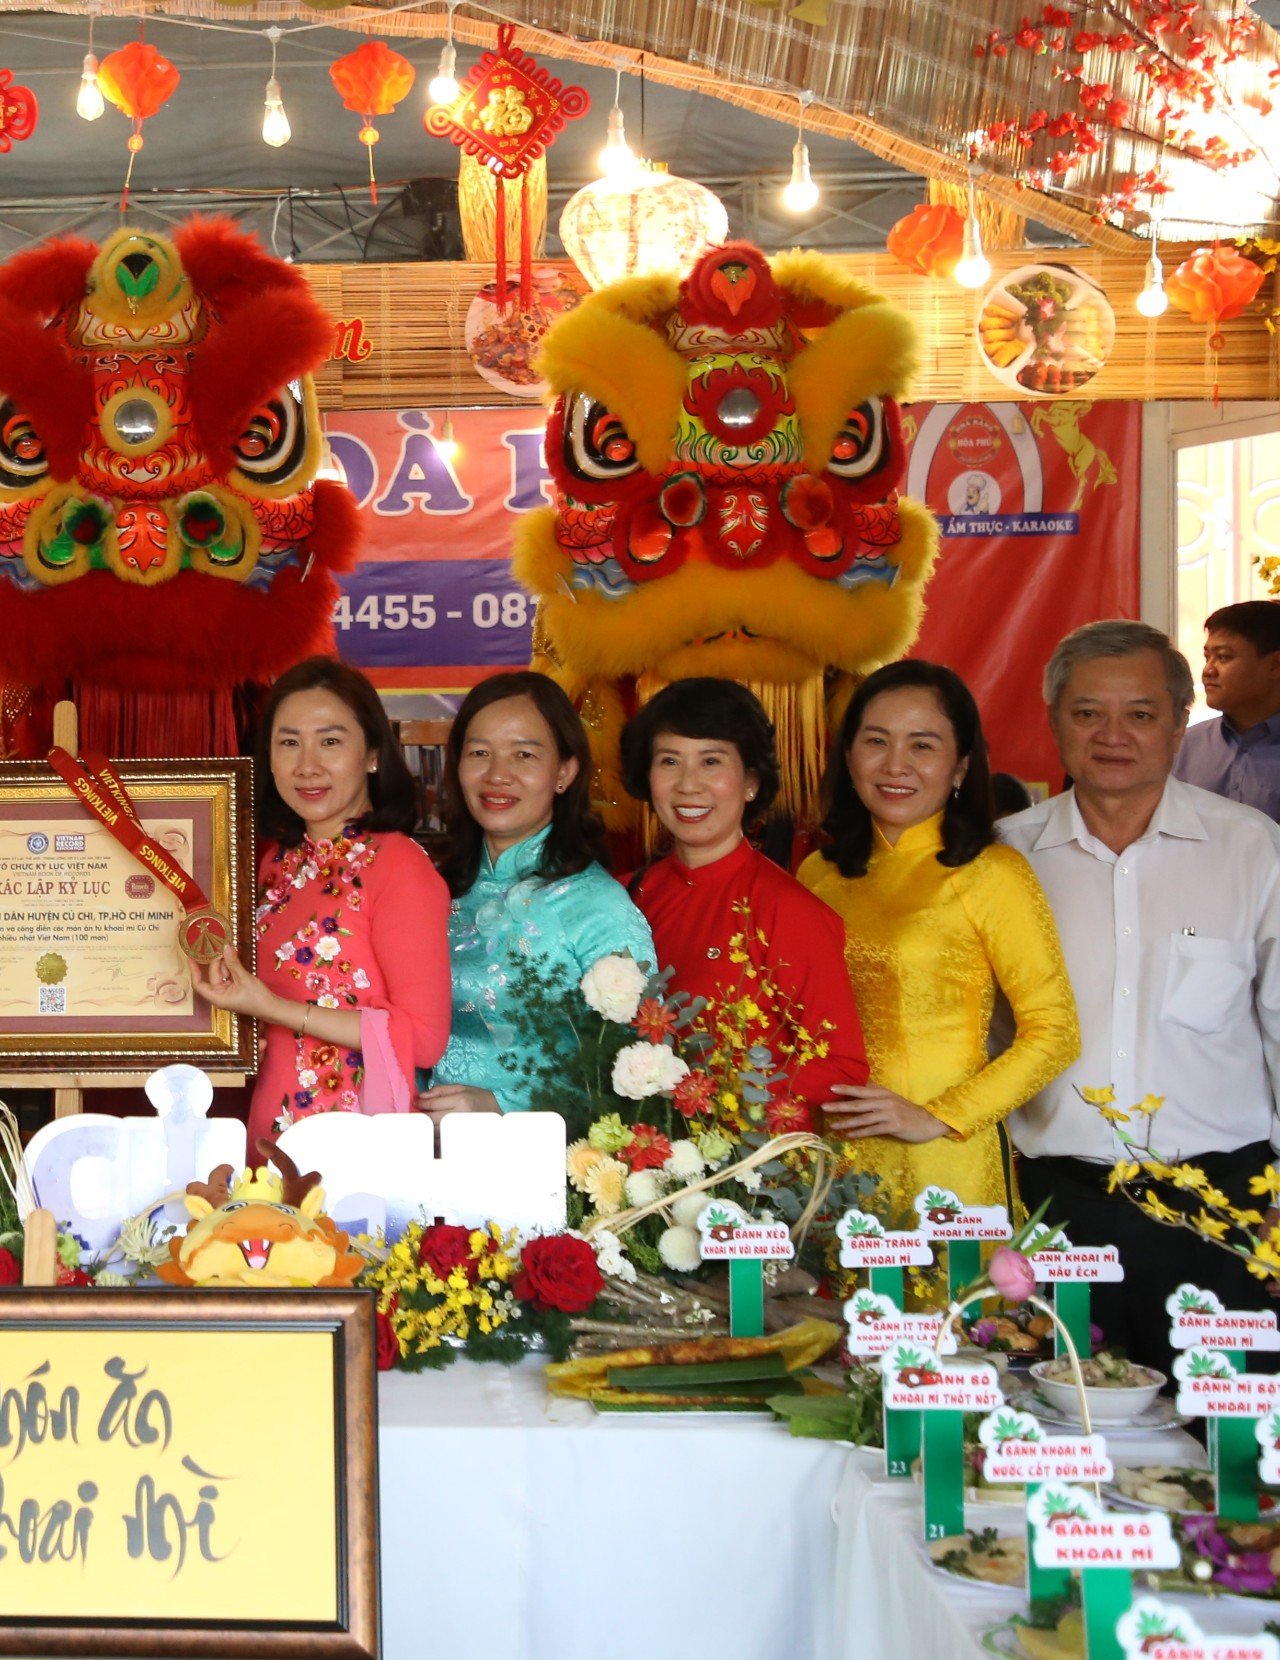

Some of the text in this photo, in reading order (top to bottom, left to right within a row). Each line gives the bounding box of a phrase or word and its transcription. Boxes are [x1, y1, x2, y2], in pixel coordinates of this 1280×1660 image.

[947, 515, 966, 533] ẨM
[970, 518, 1002, 536] THỰC
[1012, 519, 1073, 532] KARAOKE
[74, 777, 118, 826] VIETKINGS
[10, 861, 34, 871] CHỨC
[67, 861, 85, 871] VIỆT
[88, 862, 108, 870] NAM
[139, 845, 187, 893] VIETKINGS
[27, 878, 53, 898] LẬP
[59, 876, 77, 896] KỶ
[83, 881, 111, 899] LỤC
[4, 911, 25, 921] DÂN
[27, 911, 59, 923] HUYỆN
[77, 912, 96, 922] CHI,
[98, 909, 126, 921] TP.HỒ
[129, 909, 145, 921] CHÍ
[147, 911, 174, 921] MINH
[104, 924, 124, 932] khoai
[148, 924, 160, 932] Chi
[72, 934, 89, 943] (100
[956, 1215, 982, 1224] BÁNH
[734, 1228, 762, 1239] BÁNH
[932, 1229, 962, 1237] KHOAI
[965, 1227, 974, 1237] MÌ
[851, 1238, 921, 1249] BÁNH TRÁNG
[862, 1253, 910, 1265] KHOAI MÌ
[1031, 1251, 1115, 1262] CANH KHOAI MÌ
[1179, 1317, 1275, 1329] BÁNH SANDWICH
[1201, 1334, 1253, 1347] KHOAI MÌ
[971, 1372, 990, 1385] BÒ
[1192, 1381, 1251, 1393] BÁNH MÌ
[892, 1393, 924, 1404] KHOAI
[928, 1391, 939, 1403] MÌ
[97, 1356, 173, 1454] ăn
[1207, 1401, 1250, 1412] KHOAI
[1041, 1446, 1076, 1456] KHOAI
[1081, 1444, 1092, 1456] MÌ
[890, 1461, 907, 1474] 23
[1055, 1522, 1114, 1536] BÁNH
[1057, 1546, 1154, 1560] KHOAI MÌ
